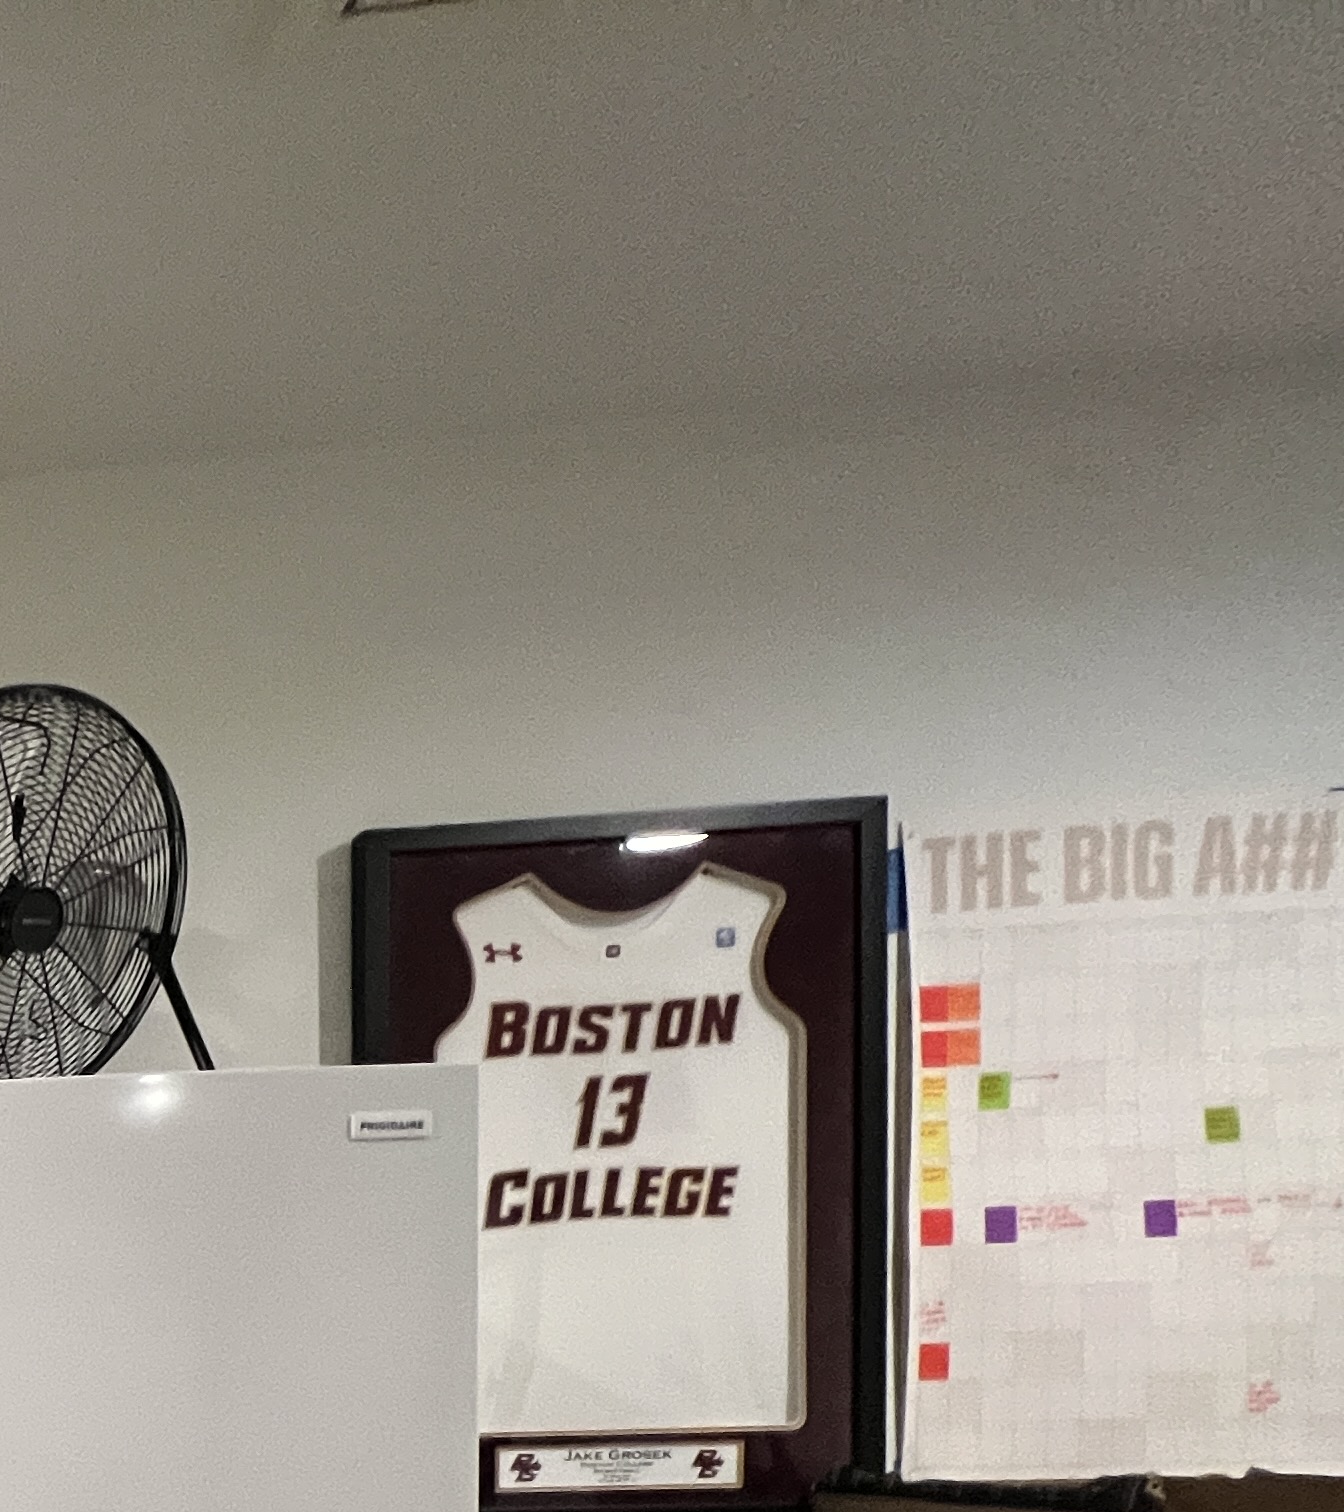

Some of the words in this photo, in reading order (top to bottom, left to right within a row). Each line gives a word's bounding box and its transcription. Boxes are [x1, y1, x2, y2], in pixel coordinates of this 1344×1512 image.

[922, 829, 1043, 914] THE
[1062, 818, 1175, 904] BIG
[483, 993, 742, 1061] BOSTON
[574, 1071, 652, 1151] 13
[482, 1165, 741, 1231] COLLEGE
[564, 1450, 603, 1462] JAKE
